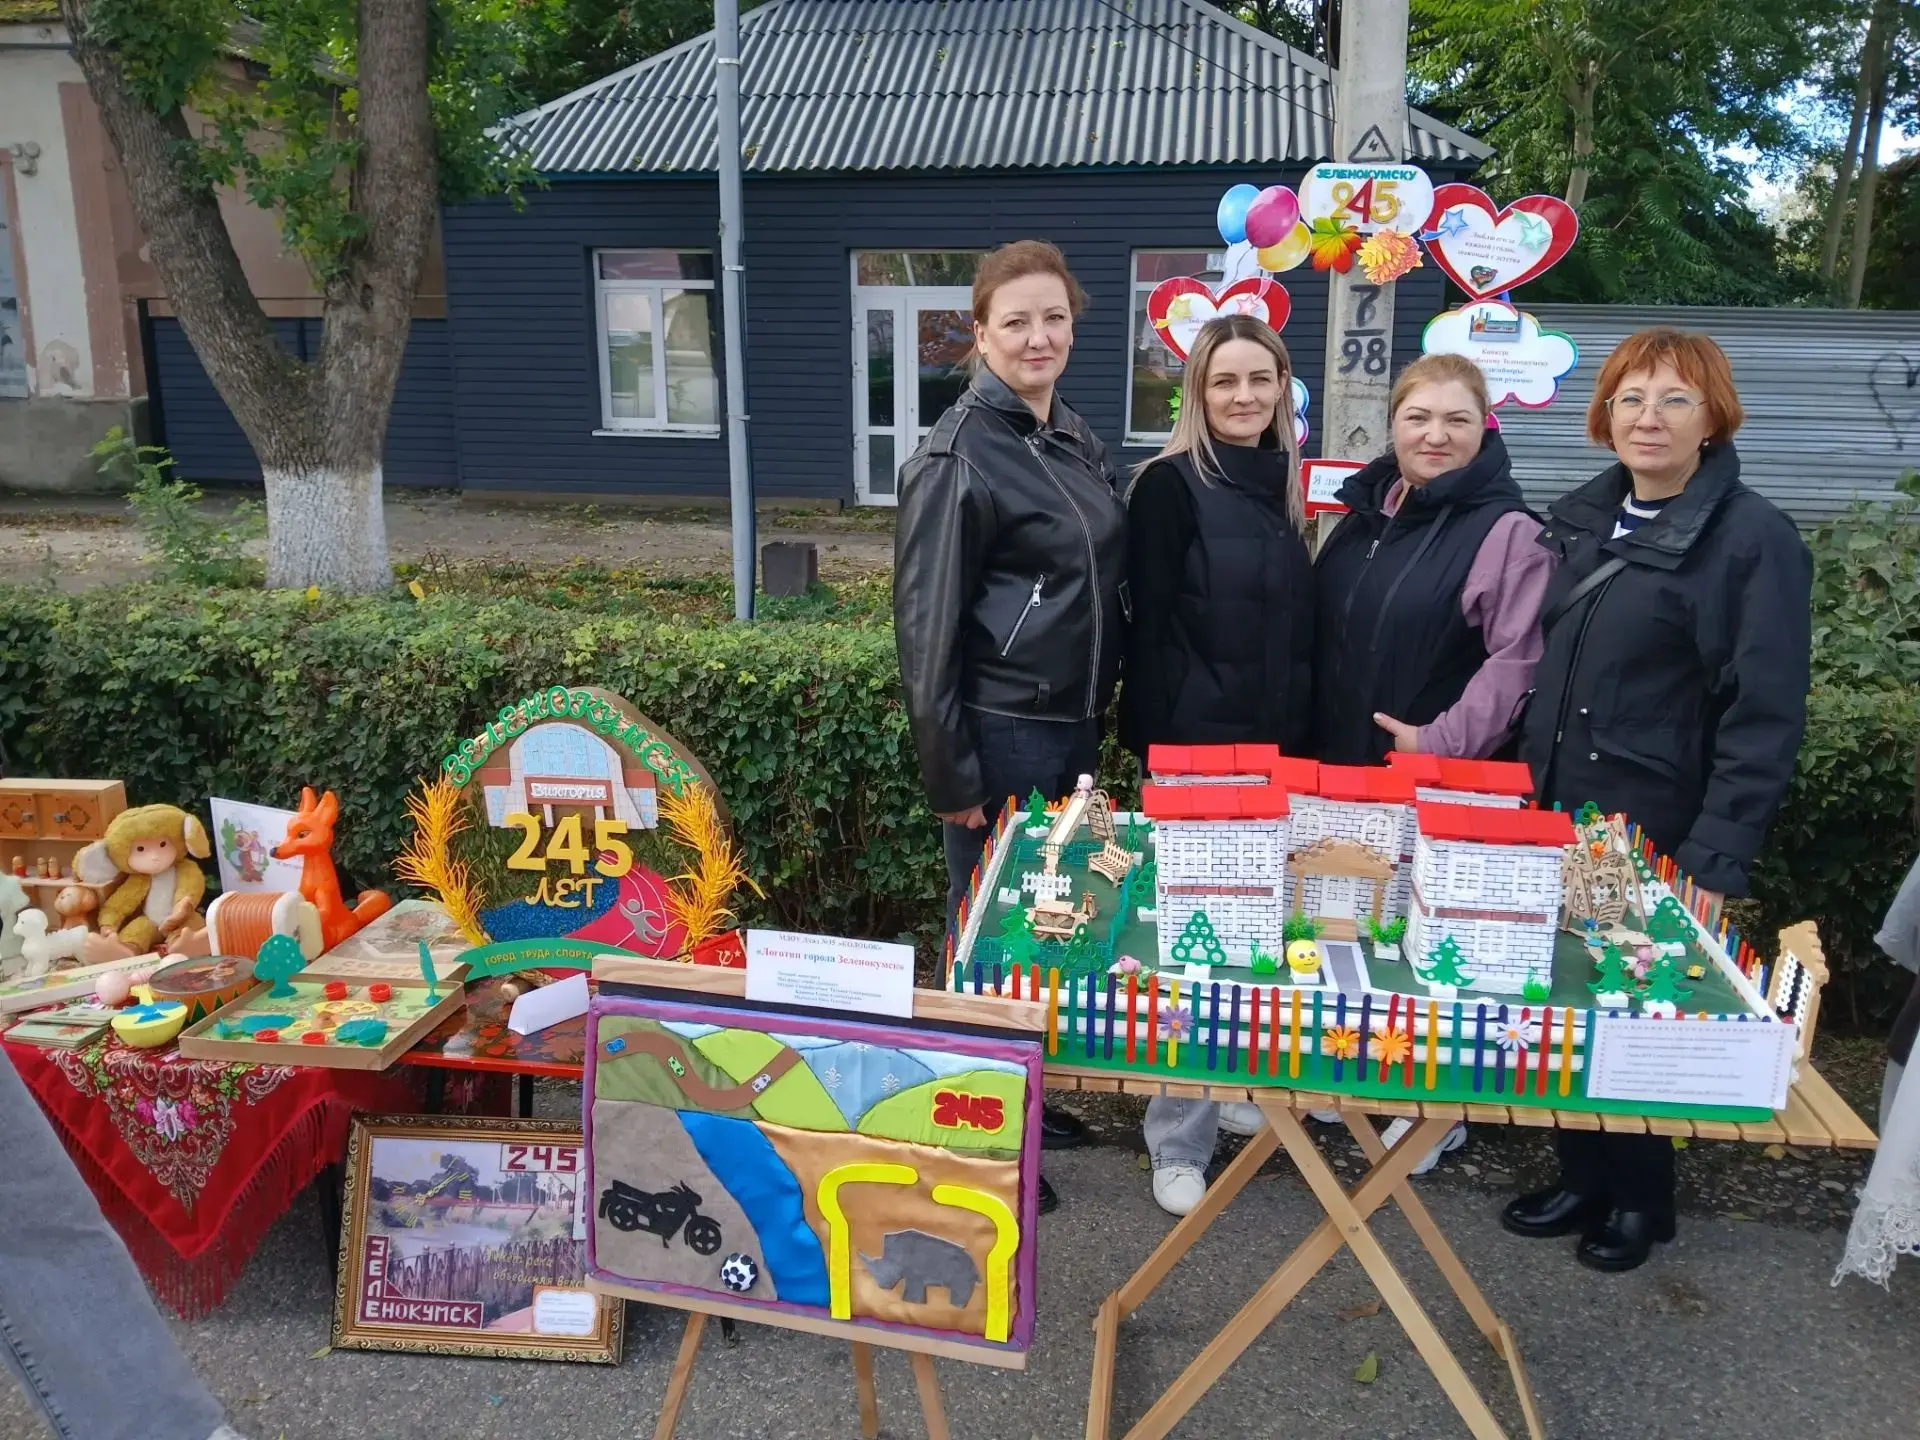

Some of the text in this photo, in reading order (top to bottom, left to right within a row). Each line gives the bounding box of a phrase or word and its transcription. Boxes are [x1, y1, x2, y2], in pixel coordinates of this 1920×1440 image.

[1316, 168, 1417, 180] ЗЕЛЕНОКУМСКУ
[1331, 177, 1398, 223] 245
[1338, 338, 1387, 376] 98
[1313, 474, 1322, 485] Я
[443, 685, 700, 798] ЗЕЛЕНОКУМСК
[503, 812, 634, 878] 245
[525, 876, 604, 908] ЛЕТ
[485, 951, 517, 967] ГОРОД
[803, 953, 836, 964] города
[932, 1088, 1005, 1134] 245
[507, 1146, 577, 1172] 245
